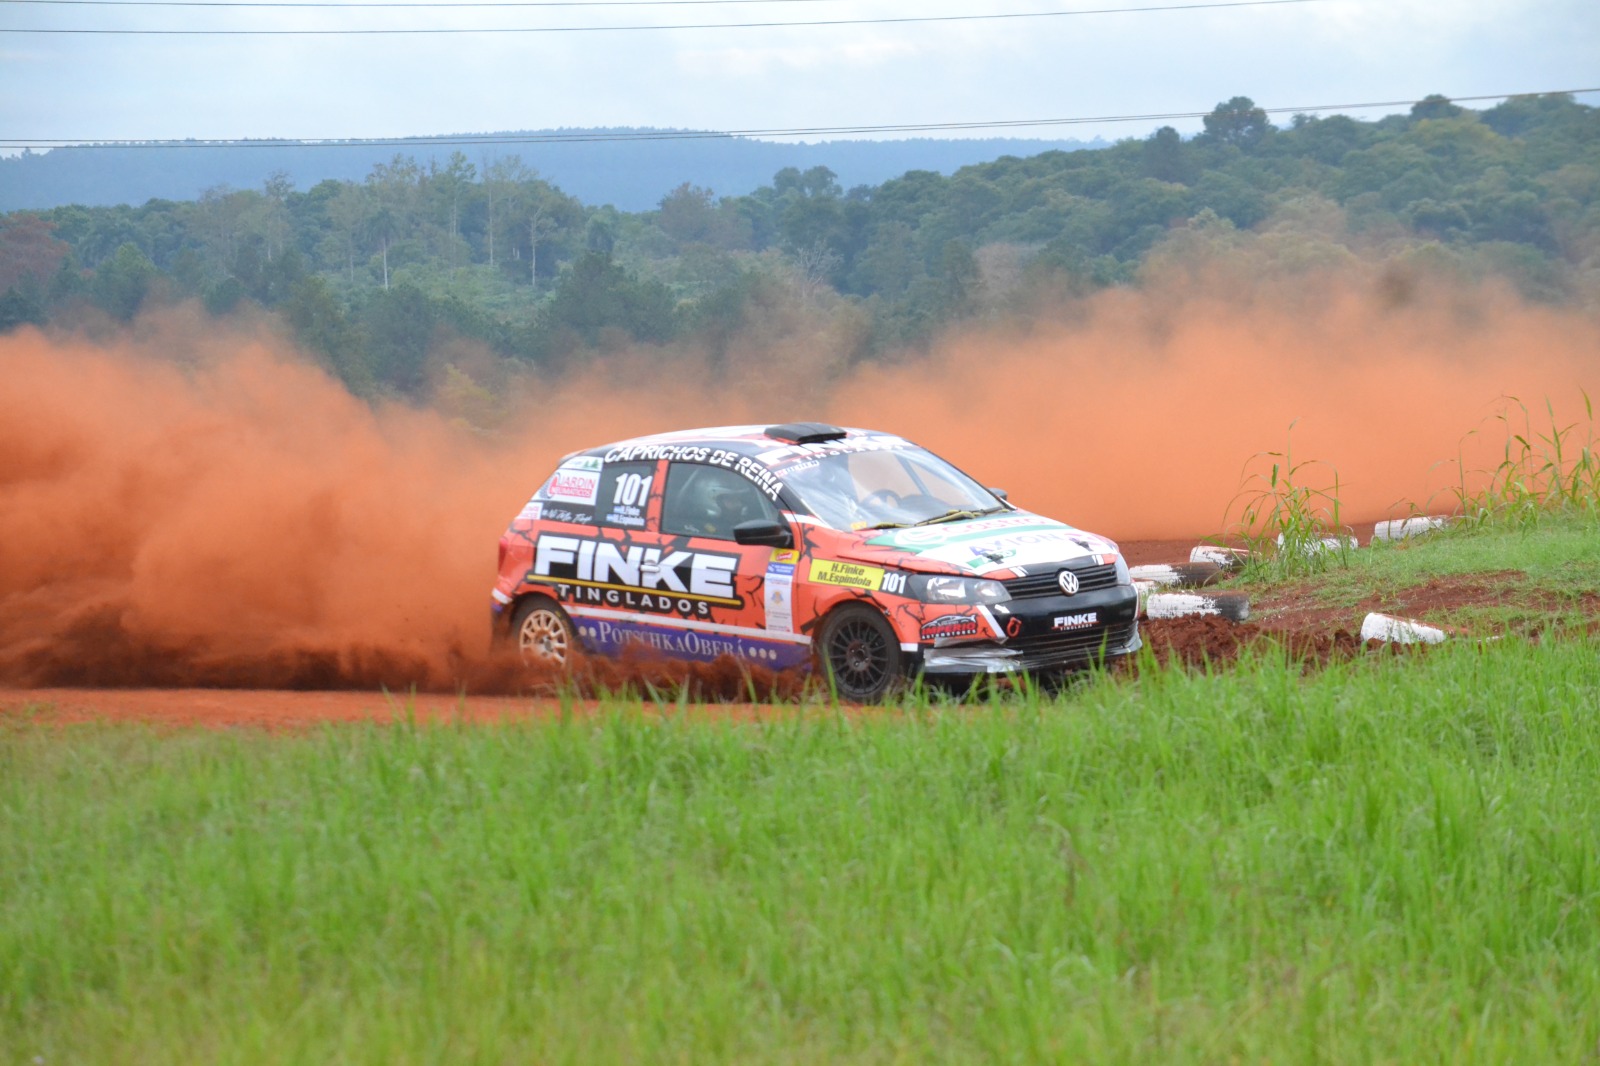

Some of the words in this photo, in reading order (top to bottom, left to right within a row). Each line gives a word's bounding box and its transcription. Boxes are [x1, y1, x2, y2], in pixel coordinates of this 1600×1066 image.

[605, 445, 711, 463] CAPRICHOS
[709, 449, 738, 467] DE
[735, 460, 784, 501] REINA
[613, 472, 653, 507] 101
[534, 535, 738, 598] FINKE
[831, 562, 866, 576] H.Finke
[882, 572, 907, 594] 101
[558, 583, 709, 615] TINGLADOS
[921, 622, 976, 634] IMPERIO
[1054, 612, 1097, 627] FINKE
